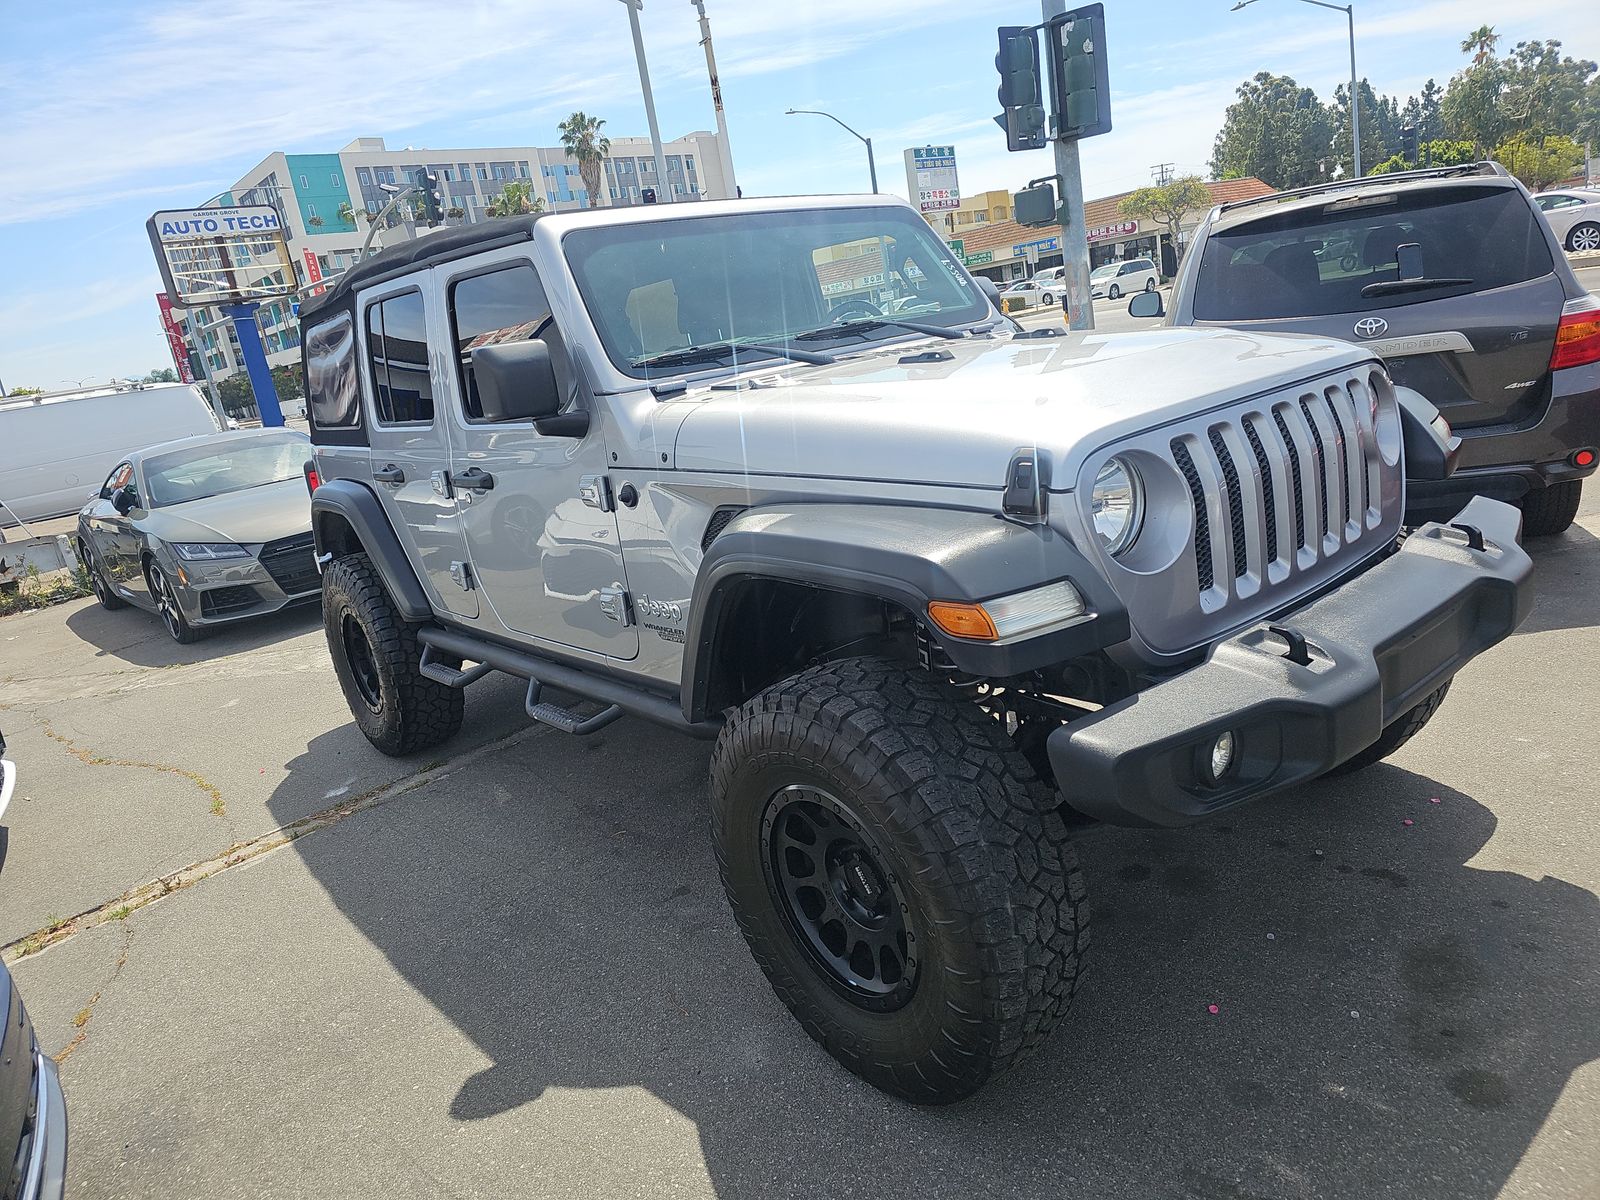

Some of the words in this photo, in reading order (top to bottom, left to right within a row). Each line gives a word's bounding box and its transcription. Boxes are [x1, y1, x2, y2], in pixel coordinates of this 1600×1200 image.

[162, 219, 218, 235] AUTO
[223, 214, 278, 231] TECH
[307, 254, 322, 293] LEASIG
[637, 593, 683, 625] Jeep
[643, 622, 685, 636] WRANGLER
